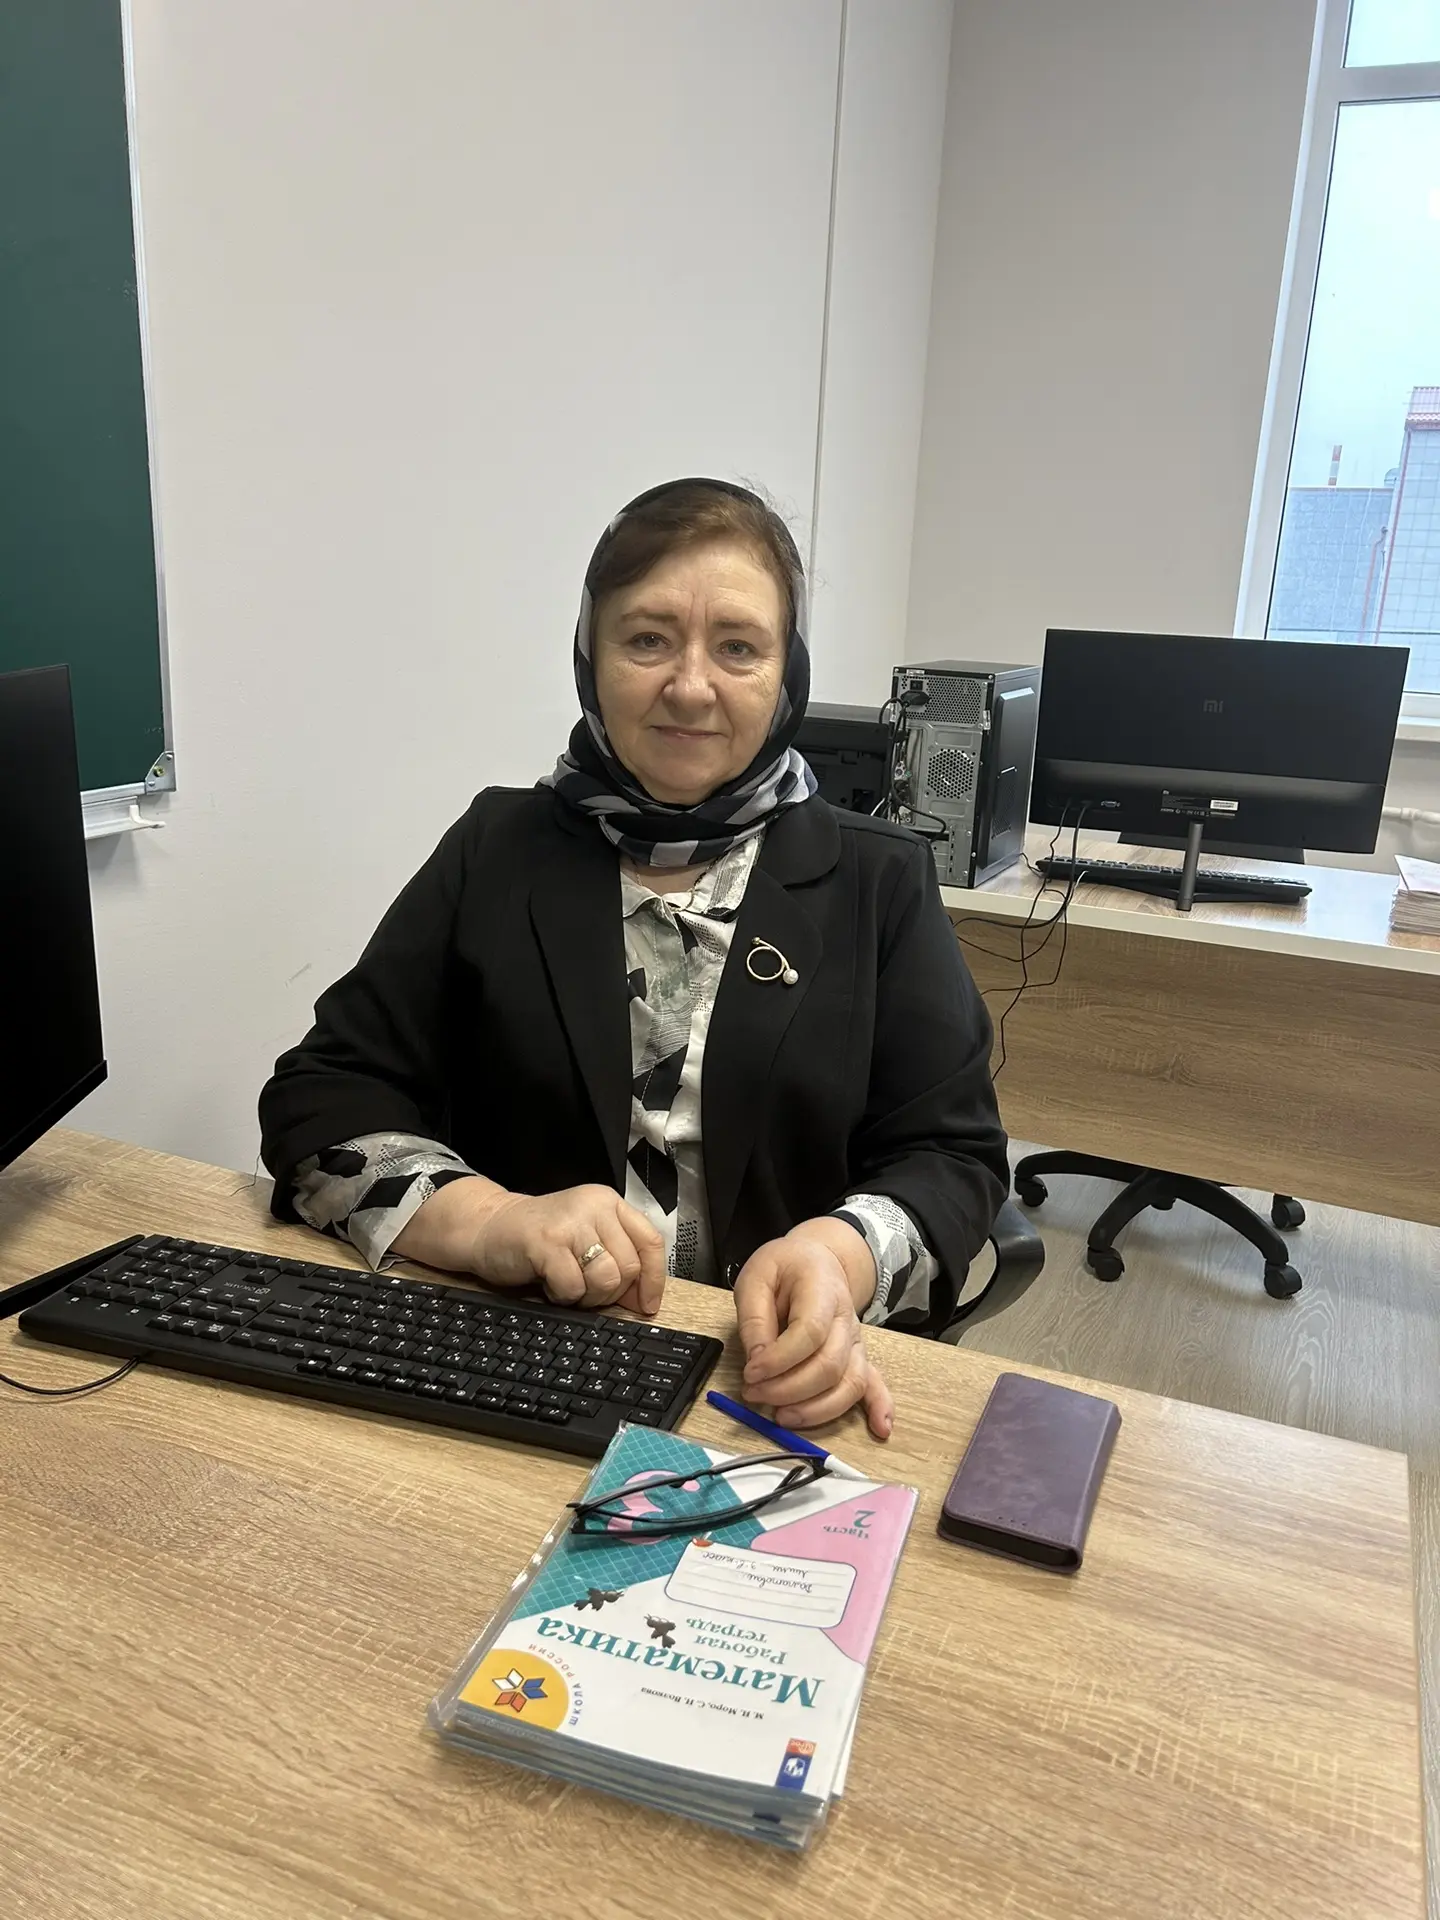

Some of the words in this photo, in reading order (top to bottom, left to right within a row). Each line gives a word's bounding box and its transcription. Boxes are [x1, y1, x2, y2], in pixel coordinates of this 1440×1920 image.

[853, 1510, 876, 1528] 2
[685, 1618, 768, 1644] тетрадь
[528, 1644, 575, 1678] РОССИИ
[537, 1617, 824, 1709] Математика
[693, 1635, 788, 1665] Рабочая
[568, 1683, 583, 1726] ШКОЛА
[640, 1687, 681, 1703] Волкова
